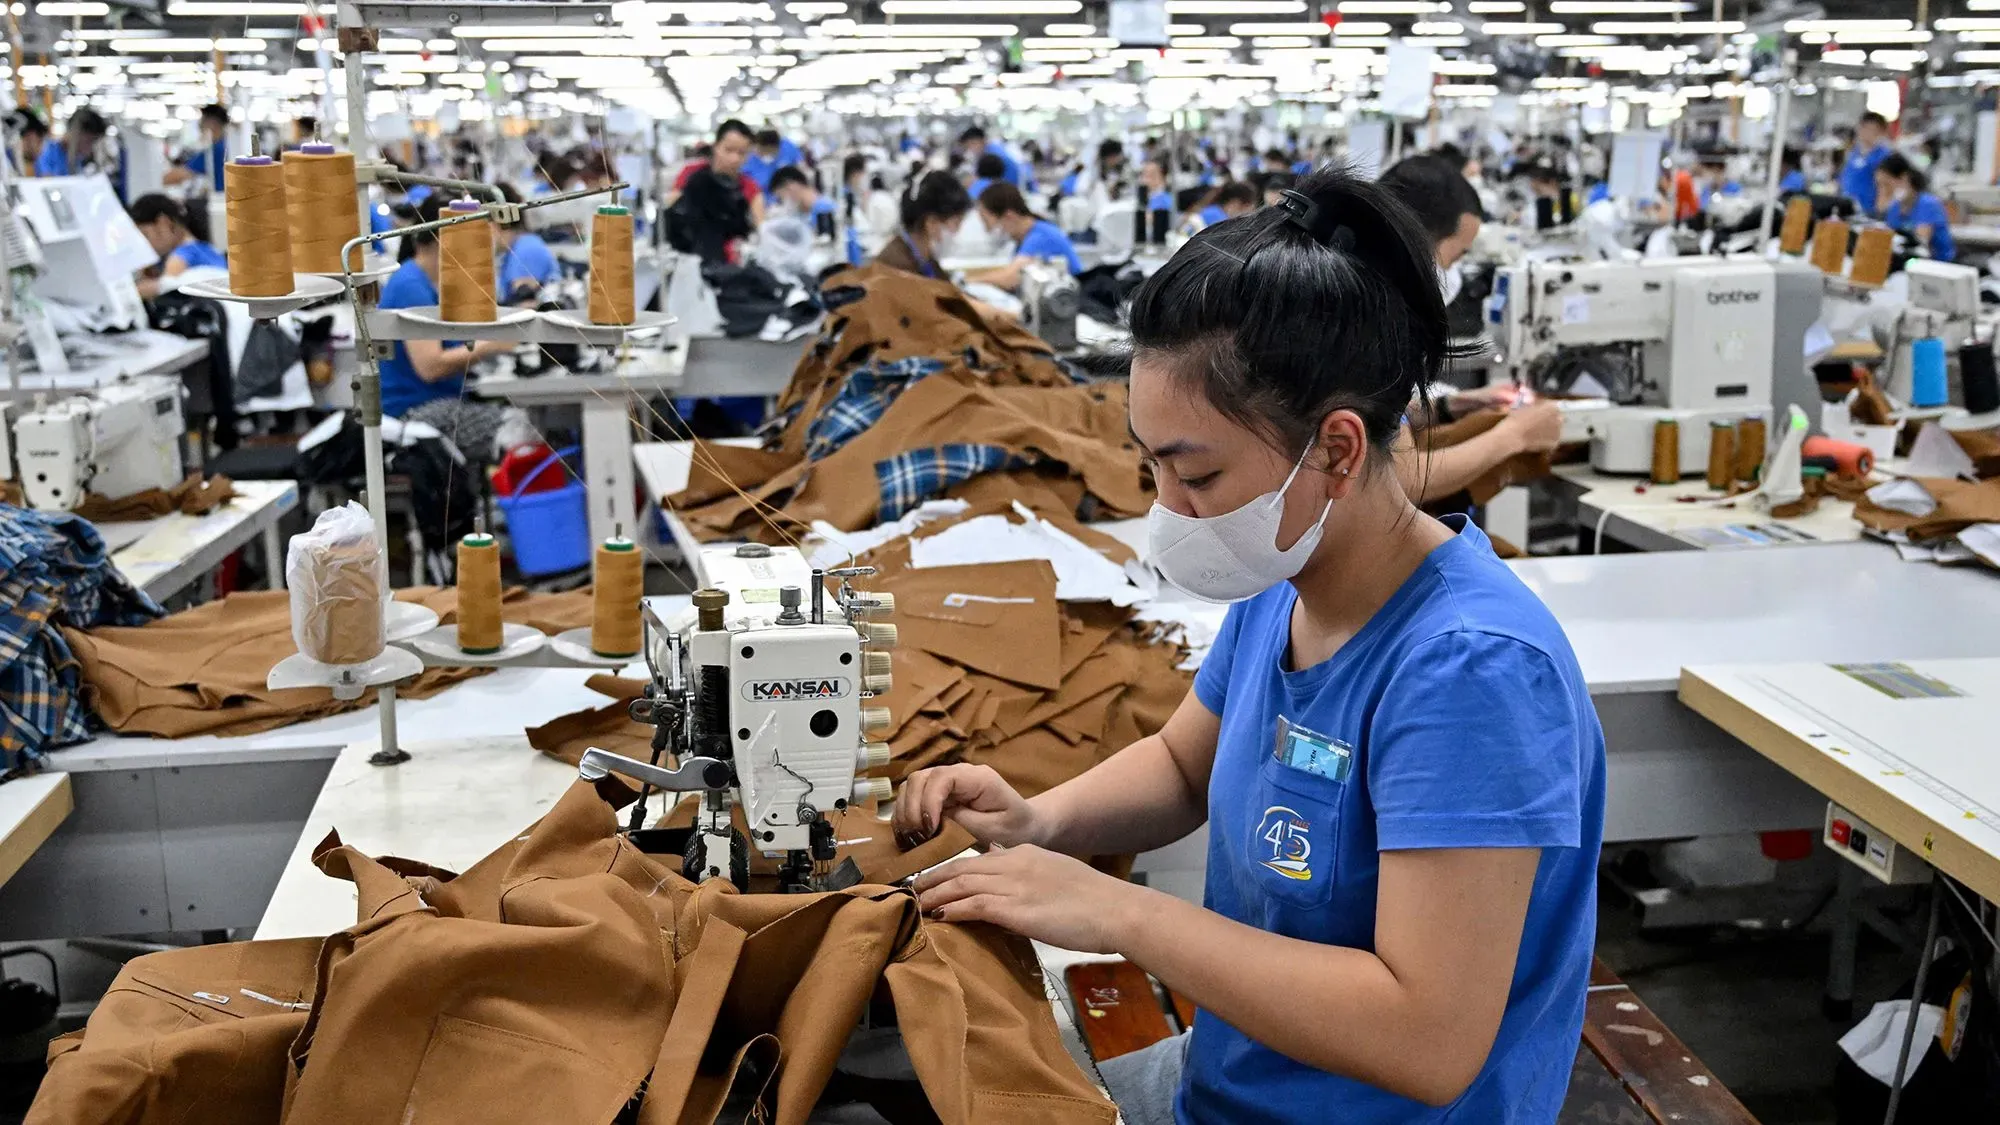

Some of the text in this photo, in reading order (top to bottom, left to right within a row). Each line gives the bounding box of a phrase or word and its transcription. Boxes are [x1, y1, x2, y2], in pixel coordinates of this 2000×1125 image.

[1707, 289, 1760, 305] brother
[753, 680, 838, 696] KANSAI
[1264, 819, 1311, 860] 45
